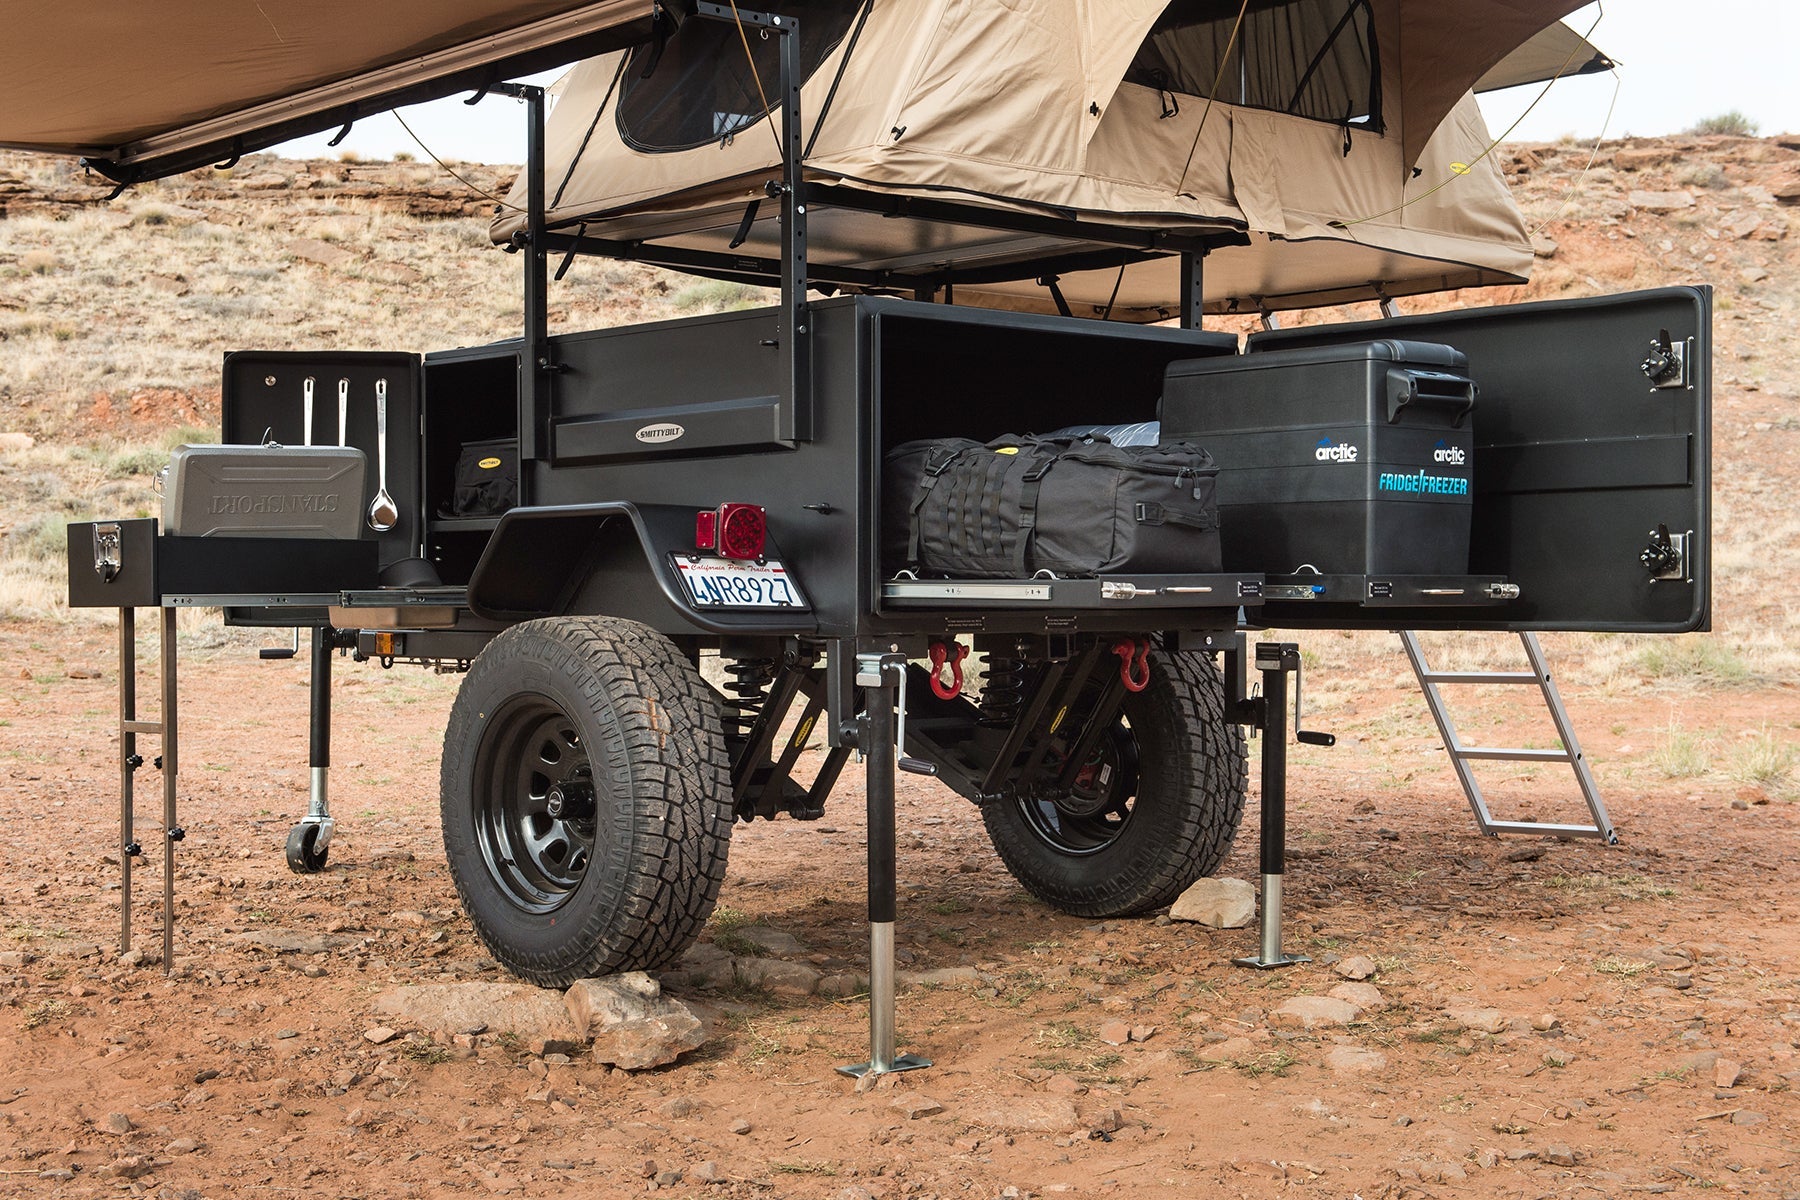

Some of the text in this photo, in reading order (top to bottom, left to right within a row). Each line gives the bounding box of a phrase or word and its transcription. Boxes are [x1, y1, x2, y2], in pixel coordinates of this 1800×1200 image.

[640, 427, 681, 439] SMITTYBILT
[1315, 443, 1358, 461] arctic
[1433, 446, 1465, 462] arctic
[208, 494, 339, 514] STANSPORT
[747, 565, 770, 573] Trailer
[689, 575, 793, 604] 4NR8927
